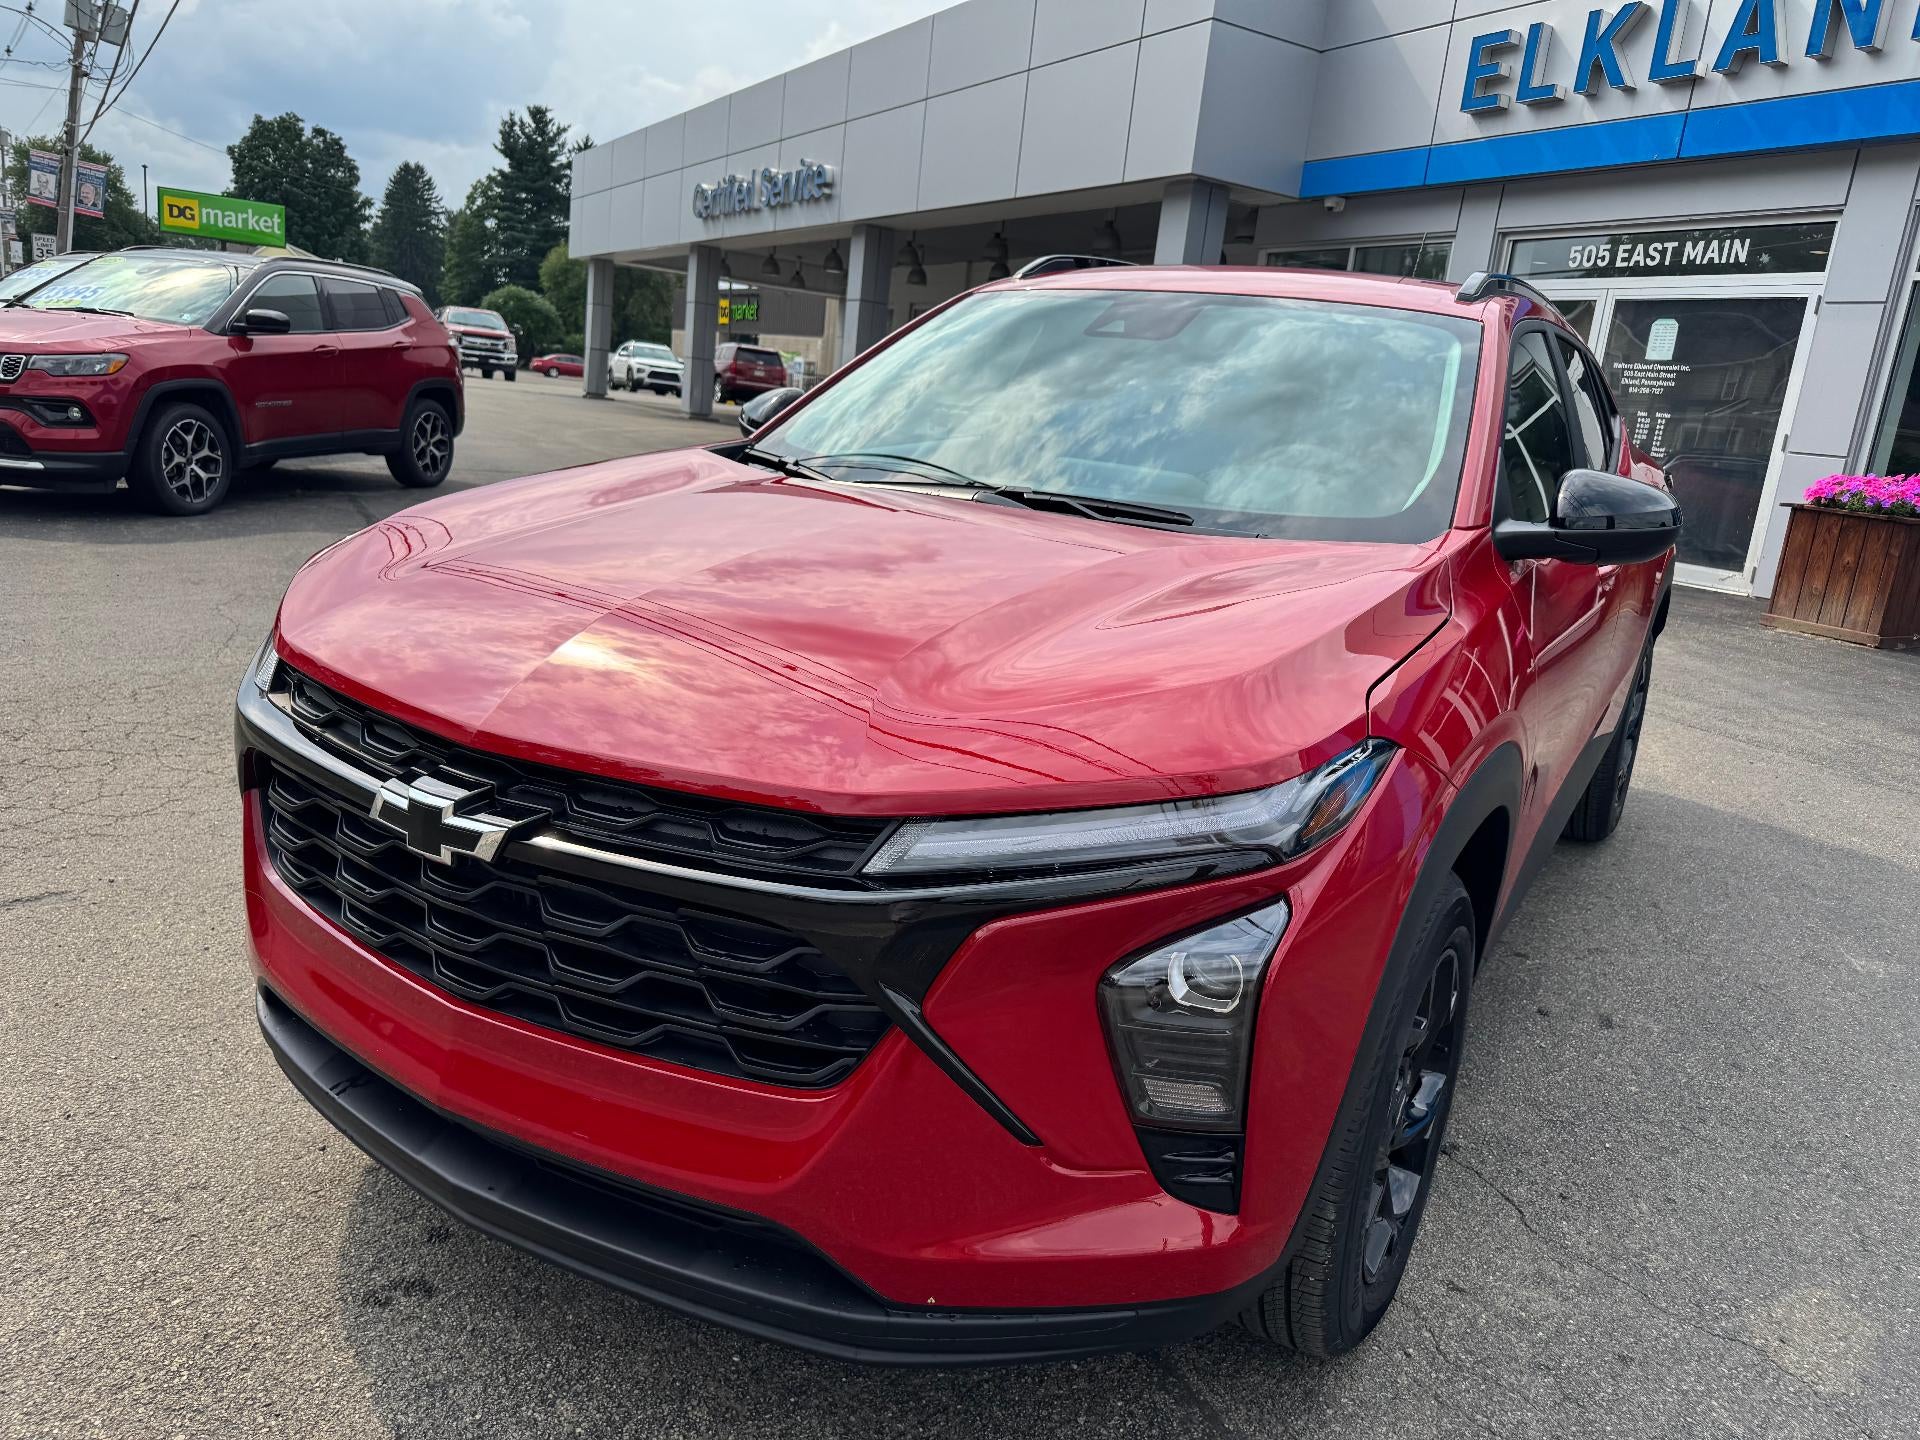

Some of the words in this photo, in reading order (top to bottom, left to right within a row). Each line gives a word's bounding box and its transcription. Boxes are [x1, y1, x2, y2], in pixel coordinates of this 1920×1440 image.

[1459, 0, 1920, 115] ELKLAN
[692, 169, 761, 219] Certified
[761, 157, 834, 208] Service
[167, 203, 196, 222] DG
[201, 207, 281, 234] market
[34, 236, 55, 244] SPEED
[35, 247, 55, 259] 35
[1568, 244, 1612, 268] 505
[1615, 241, 1679, 268] EAST
[1681, 238, 1751, 265] MAIN
[731, 303, 758, 321] market
[1634, 362, 1653, 370] Elkland
[1653, 363, 1680, 371] Chevrolet
[1680, 364, 1691, 372] Inc.
[1640, 378, 1676, 387] Pennsylvania
[1659, 371, 1677, 379] Street
